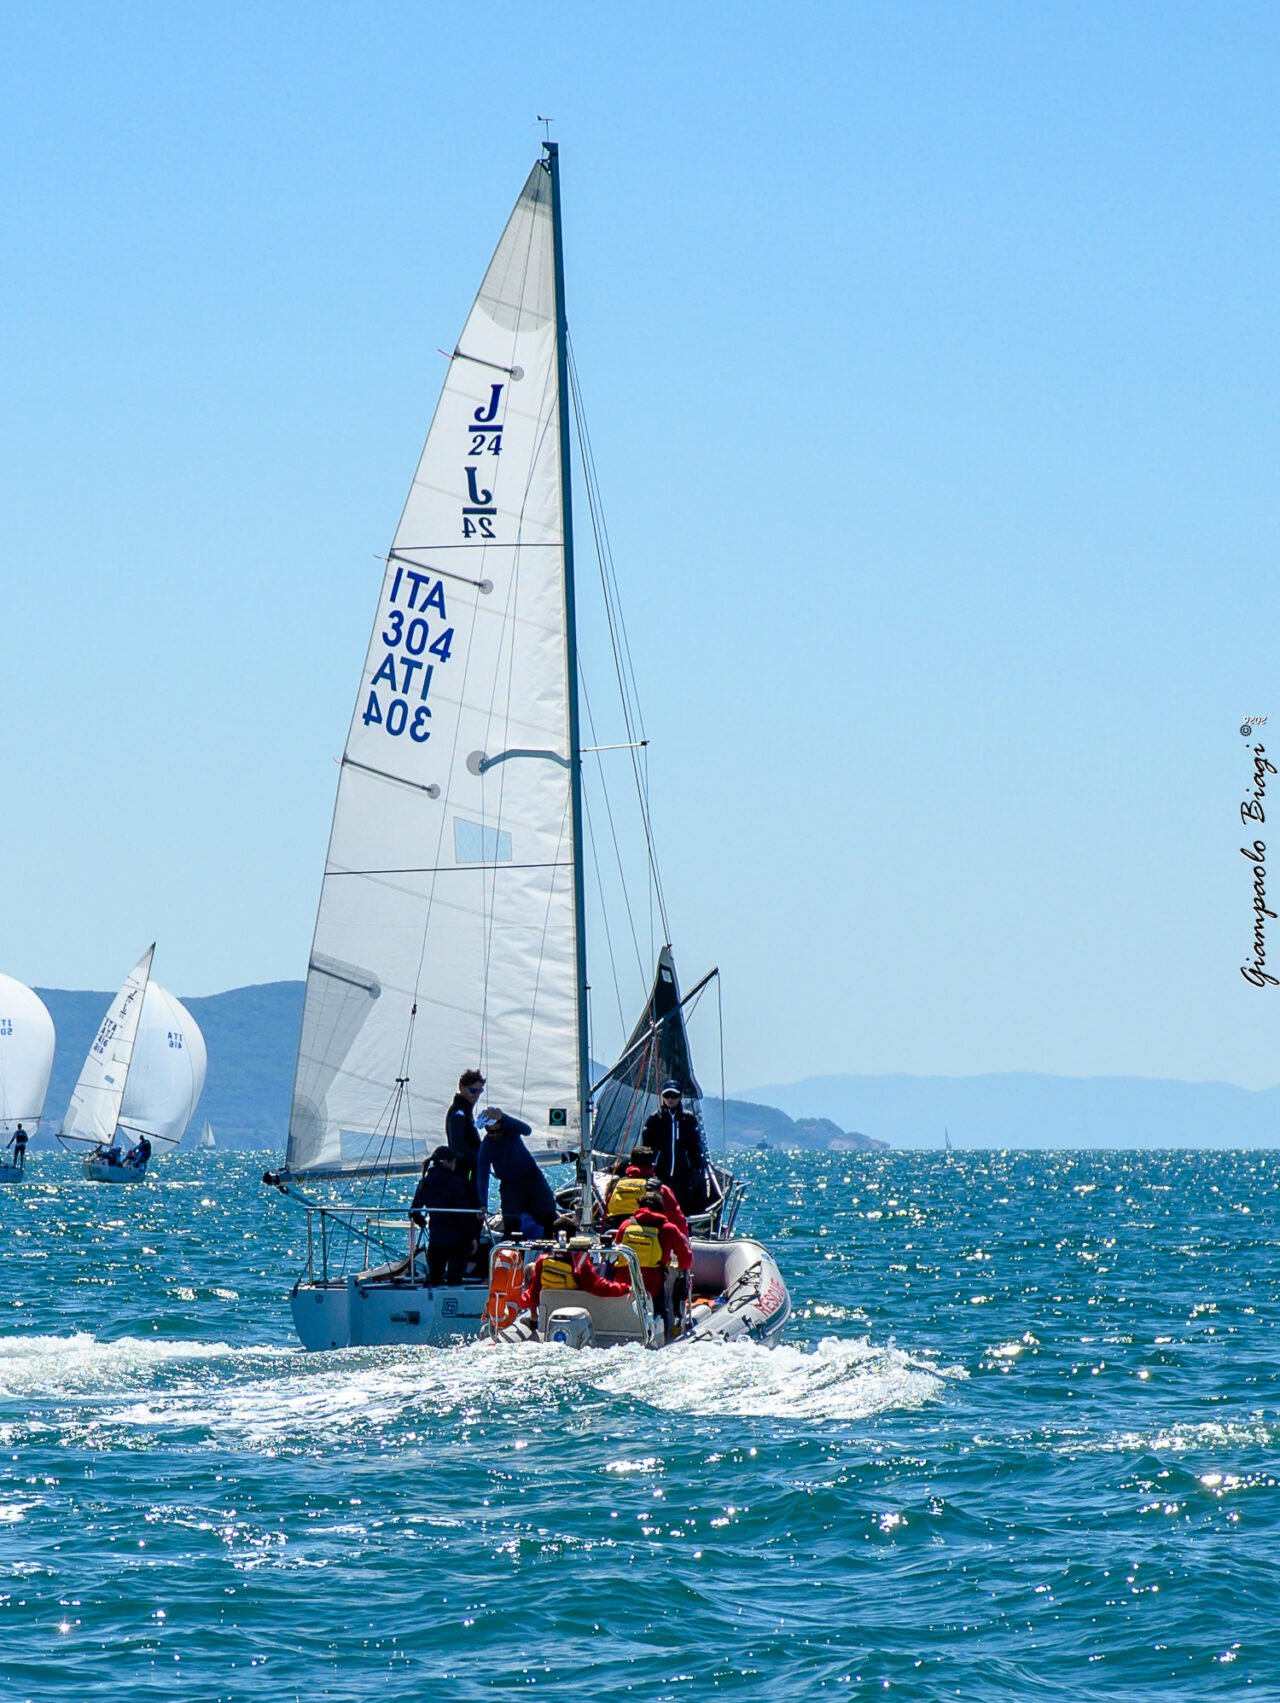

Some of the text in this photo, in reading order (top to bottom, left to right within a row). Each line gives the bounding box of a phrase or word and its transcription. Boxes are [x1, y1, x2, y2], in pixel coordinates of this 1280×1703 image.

[473, 383, 505, 423] J
[467, 434, 504, 456] 24
[389, 567, 448, 620] ITA
[381, 609, 455, 663] 304
